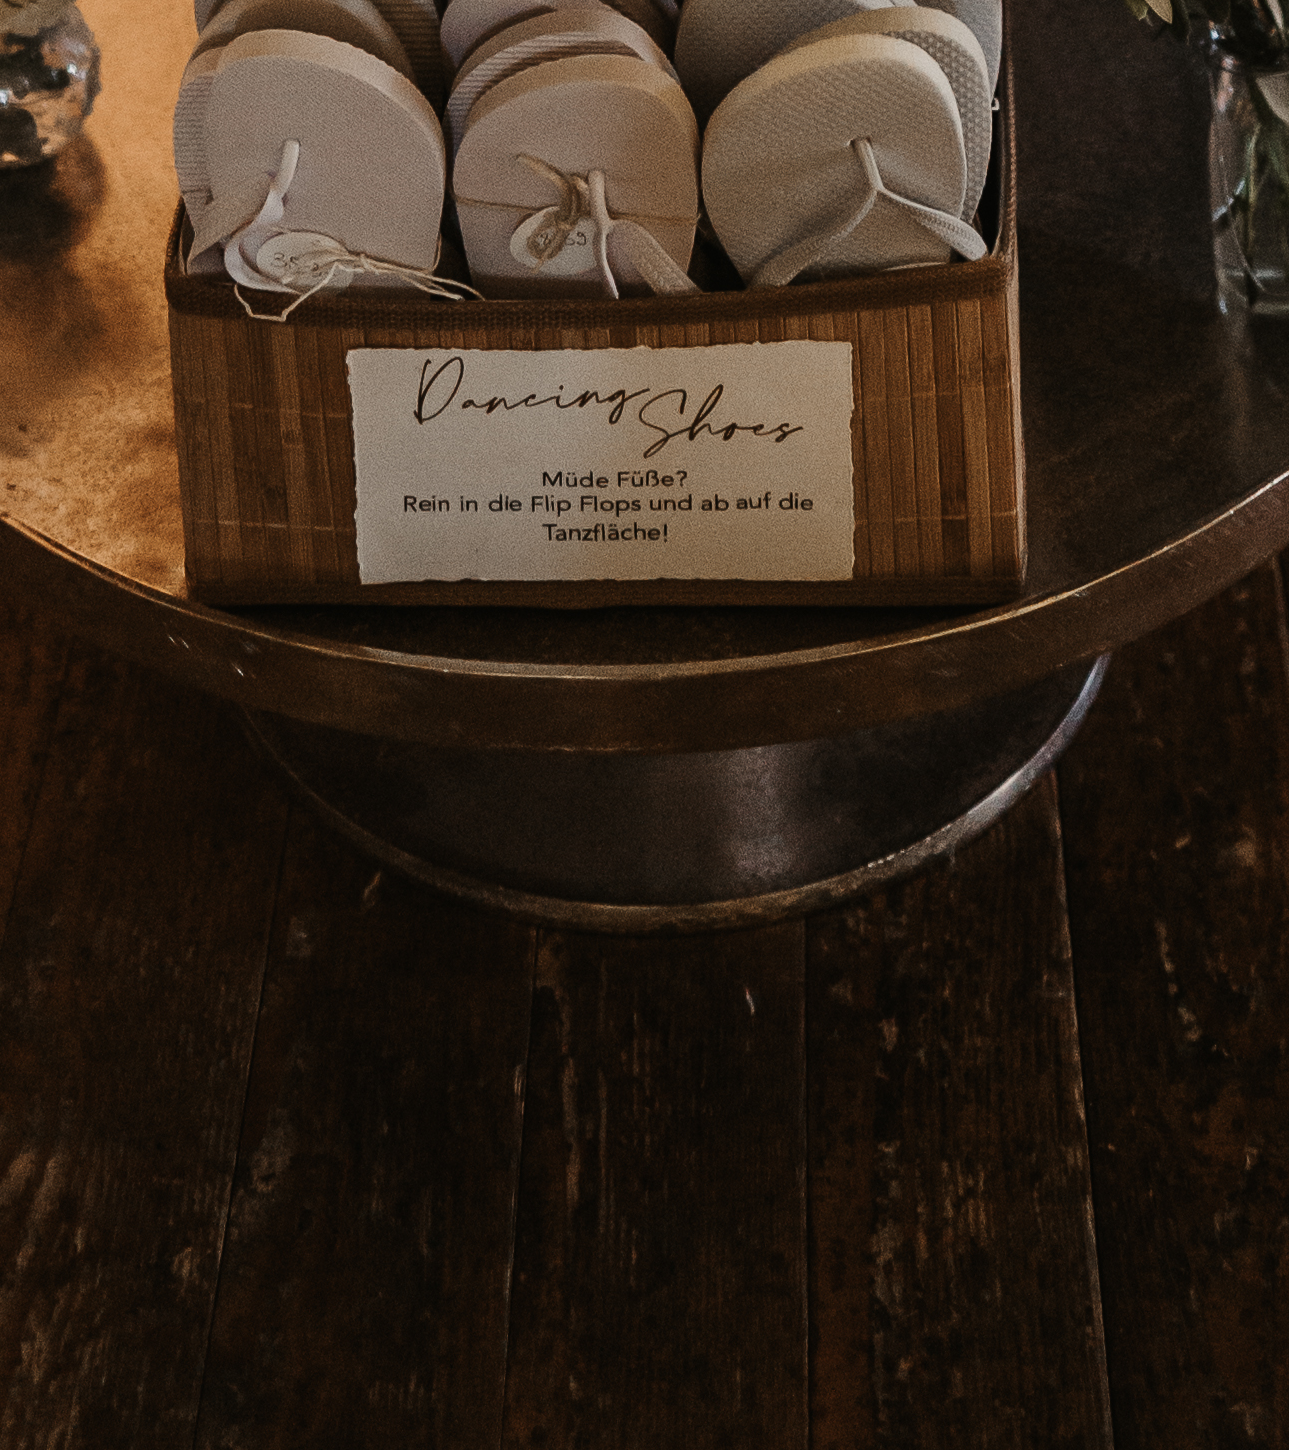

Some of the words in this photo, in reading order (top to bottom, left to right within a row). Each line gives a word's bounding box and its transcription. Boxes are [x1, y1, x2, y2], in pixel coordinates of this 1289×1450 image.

[413, 356, 651, 425] Dancing
[638, 384, 804, 458] Shoes
[541, 470, 610, 489] Müde
[616, 469, 688, 488] Füße?
[403, 494, 451, 513] Rein
[459, 495, 479, 513] in
[487, 493, 523, 513] die
[530, 494, 572, 518] Flip
[579, 494, 642, 518] Flops
[648, 493, 693, 512] und
[700, 493, 730, 512] ab
[735, 491, 772, 511] auf
[778, 492, 814, 512] die
[542, 521, 669, 543] Tanzfläche!
